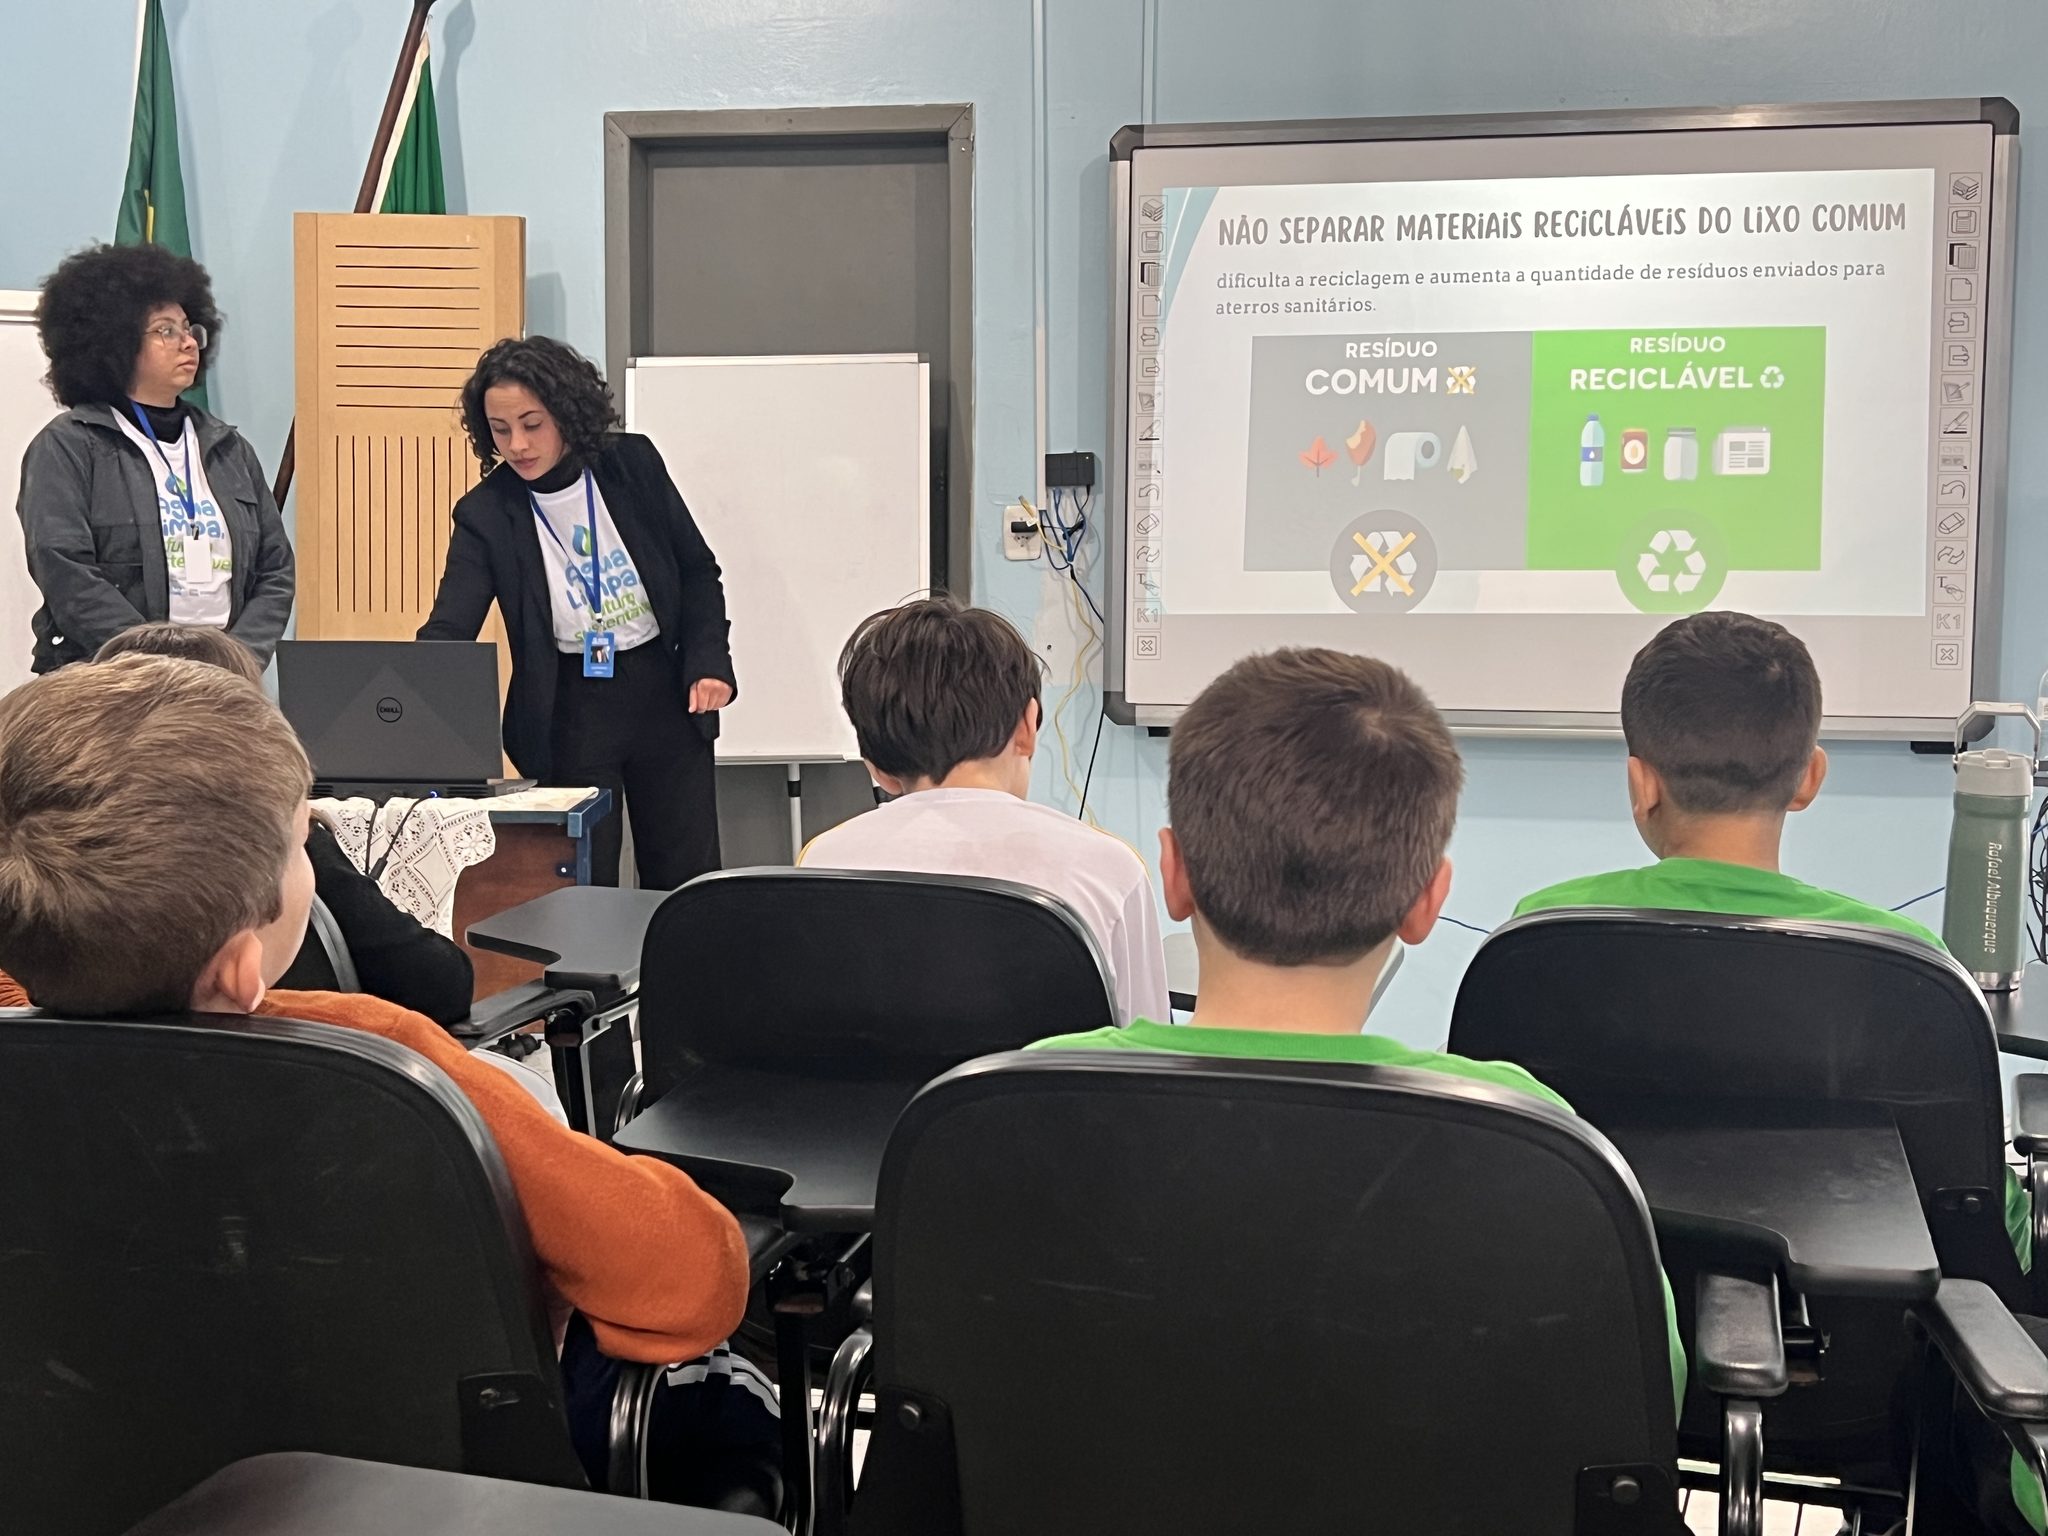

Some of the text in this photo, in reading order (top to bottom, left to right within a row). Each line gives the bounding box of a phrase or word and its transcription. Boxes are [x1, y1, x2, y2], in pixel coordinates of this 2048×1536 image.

[1218, 214, 1269, 246] NÃO
[1279, 214, 1385, 245] SEPARAR
[1698, 206, 1732, 235] DO
[1812, 202, 1906, 232] COMUM
[1216, 260, 1886, 289] dificulta a reciclagem e aumenta a quantidade de resíduos enviados para
[1215, 297, 1376, 315] aterros sanitários.
[1345, 337, 1438, 359] RESÍDUO
[1630, 332, 1726, 354] RESÍDUO
[1305, 367, 1438, 396] COMUM
[1570, 360, 1753, 391] RECICLÁVEL
[1982, 841, 2003, 954] Rafael Albuquerque
